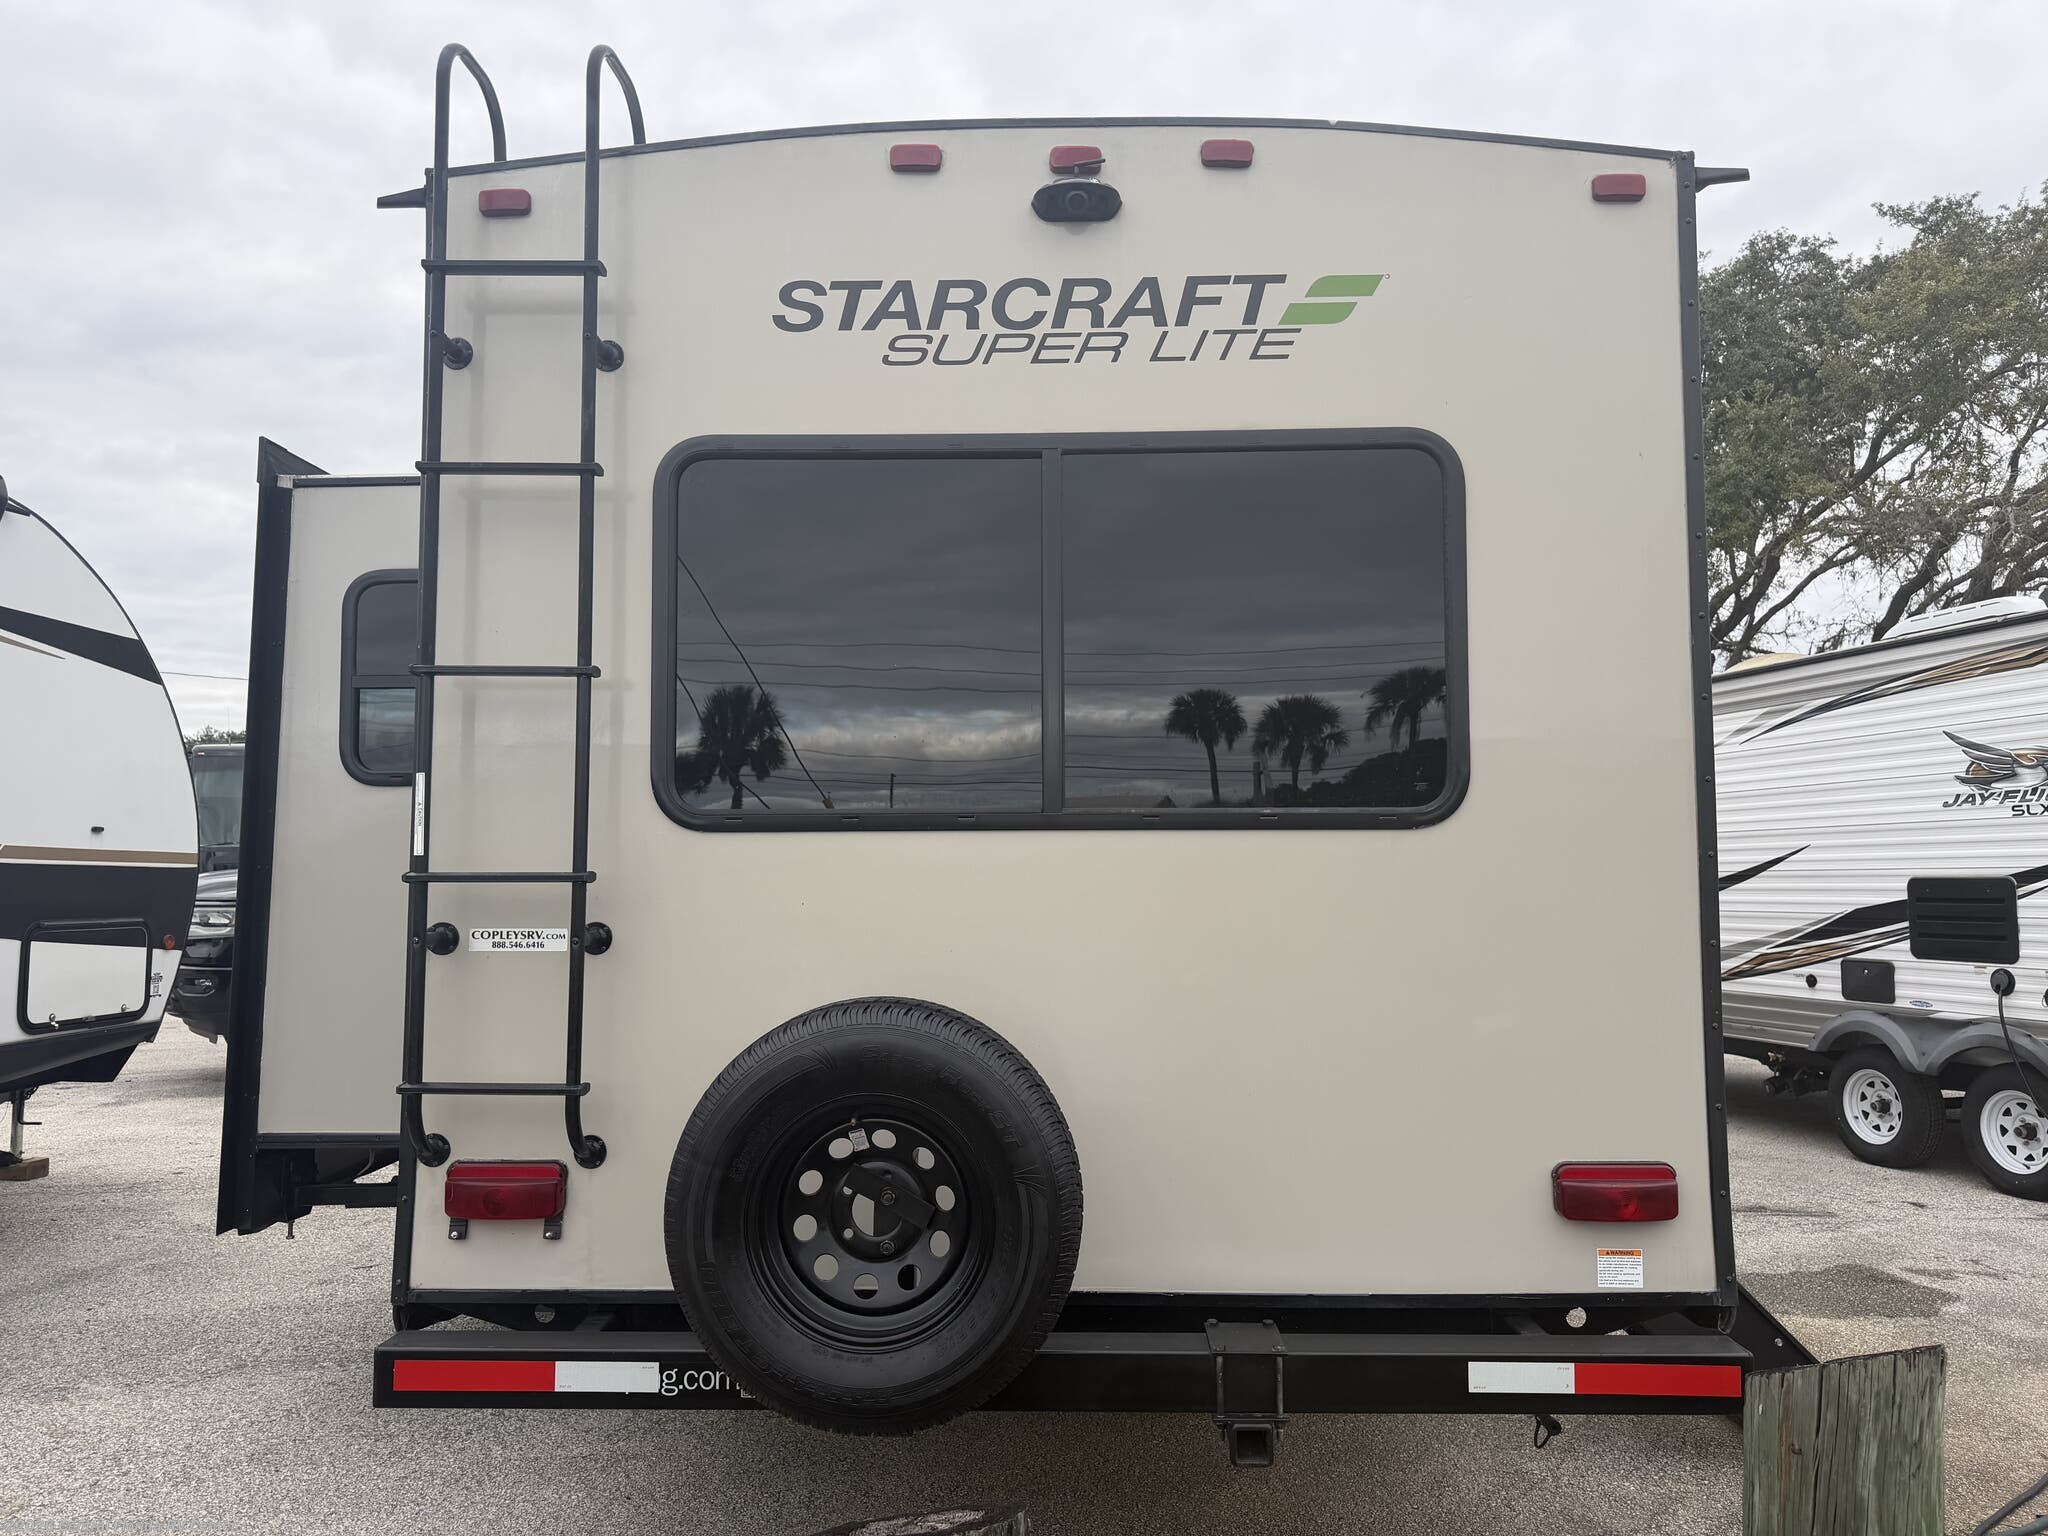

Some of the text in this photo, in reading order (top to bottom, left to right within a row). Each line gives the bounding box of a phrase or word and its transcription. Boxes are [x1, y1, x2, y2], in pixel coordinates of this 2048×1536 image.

[772, 274, 1287, 332] STARCRAFT
[882, 327, 1302, 366] SUPER LITE
[491, 941, 545, 949] 888.546.6416
